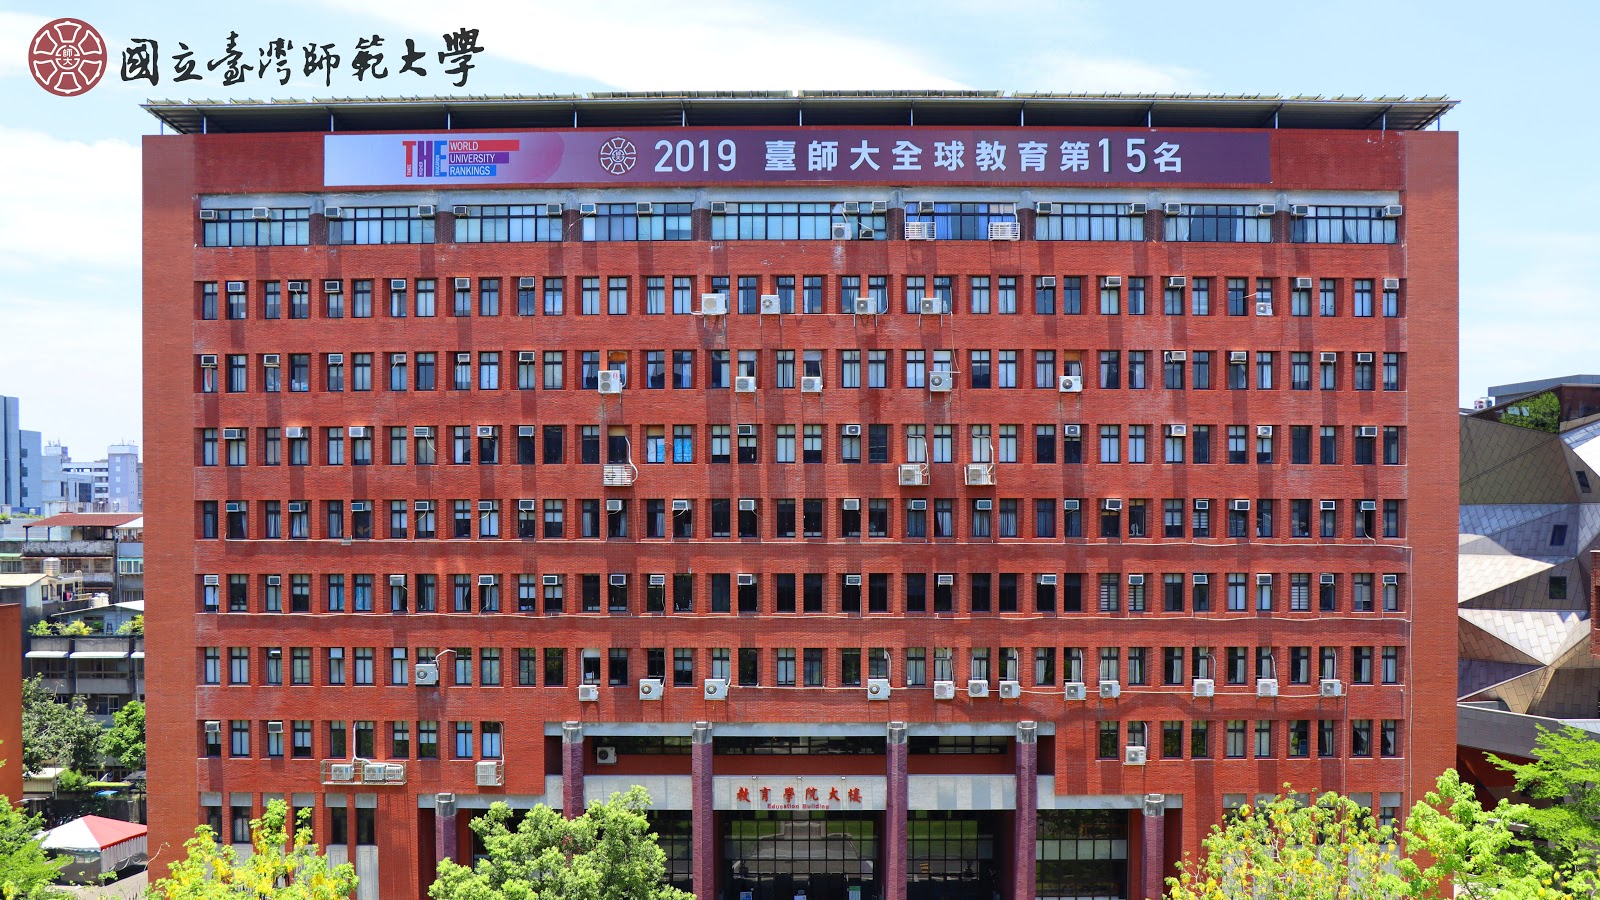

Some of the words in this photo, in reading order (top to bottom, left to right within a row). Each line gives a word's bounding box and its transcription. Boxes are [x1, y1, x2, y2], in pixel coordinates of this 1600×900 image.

[449, 141, 479, 151] WORLD
[402, 140, 448, 178] THE
[449, 153, 496, 164] UNIVERSITY
[654, 139, 737, 173] 2019
[764, 138, 1183, 173] 臺師大全球教育第15名
[449, 165, 491, 176] RANKINGS
[736, 786, 863, 804] 教育學院大樓
